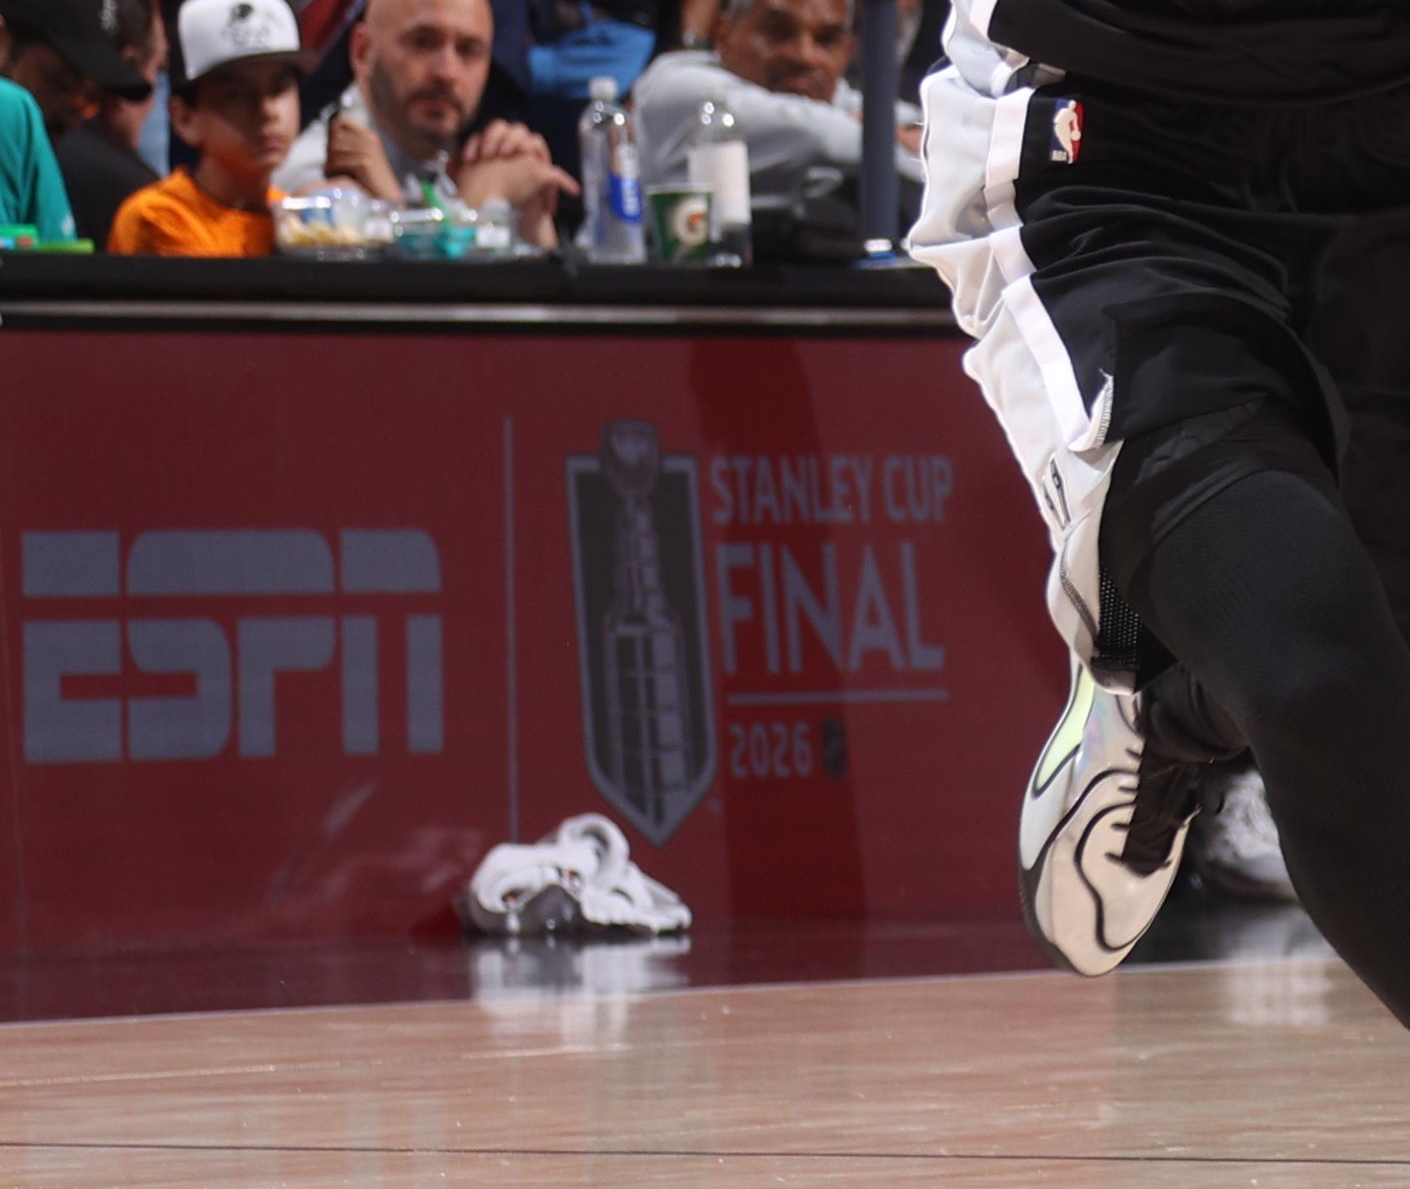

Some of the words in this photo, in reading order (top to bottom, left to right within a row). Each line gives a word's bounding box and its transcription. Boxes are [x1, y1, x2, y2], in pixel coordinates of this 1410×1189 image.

[710, 456, 873, 524] STANLEY
[883, 455, 952, 523] CUP
[22, 528, 444, 763] ESPN
[715, 541, 945, 674] FINAL
[729, 722, 813, 779] 2026
